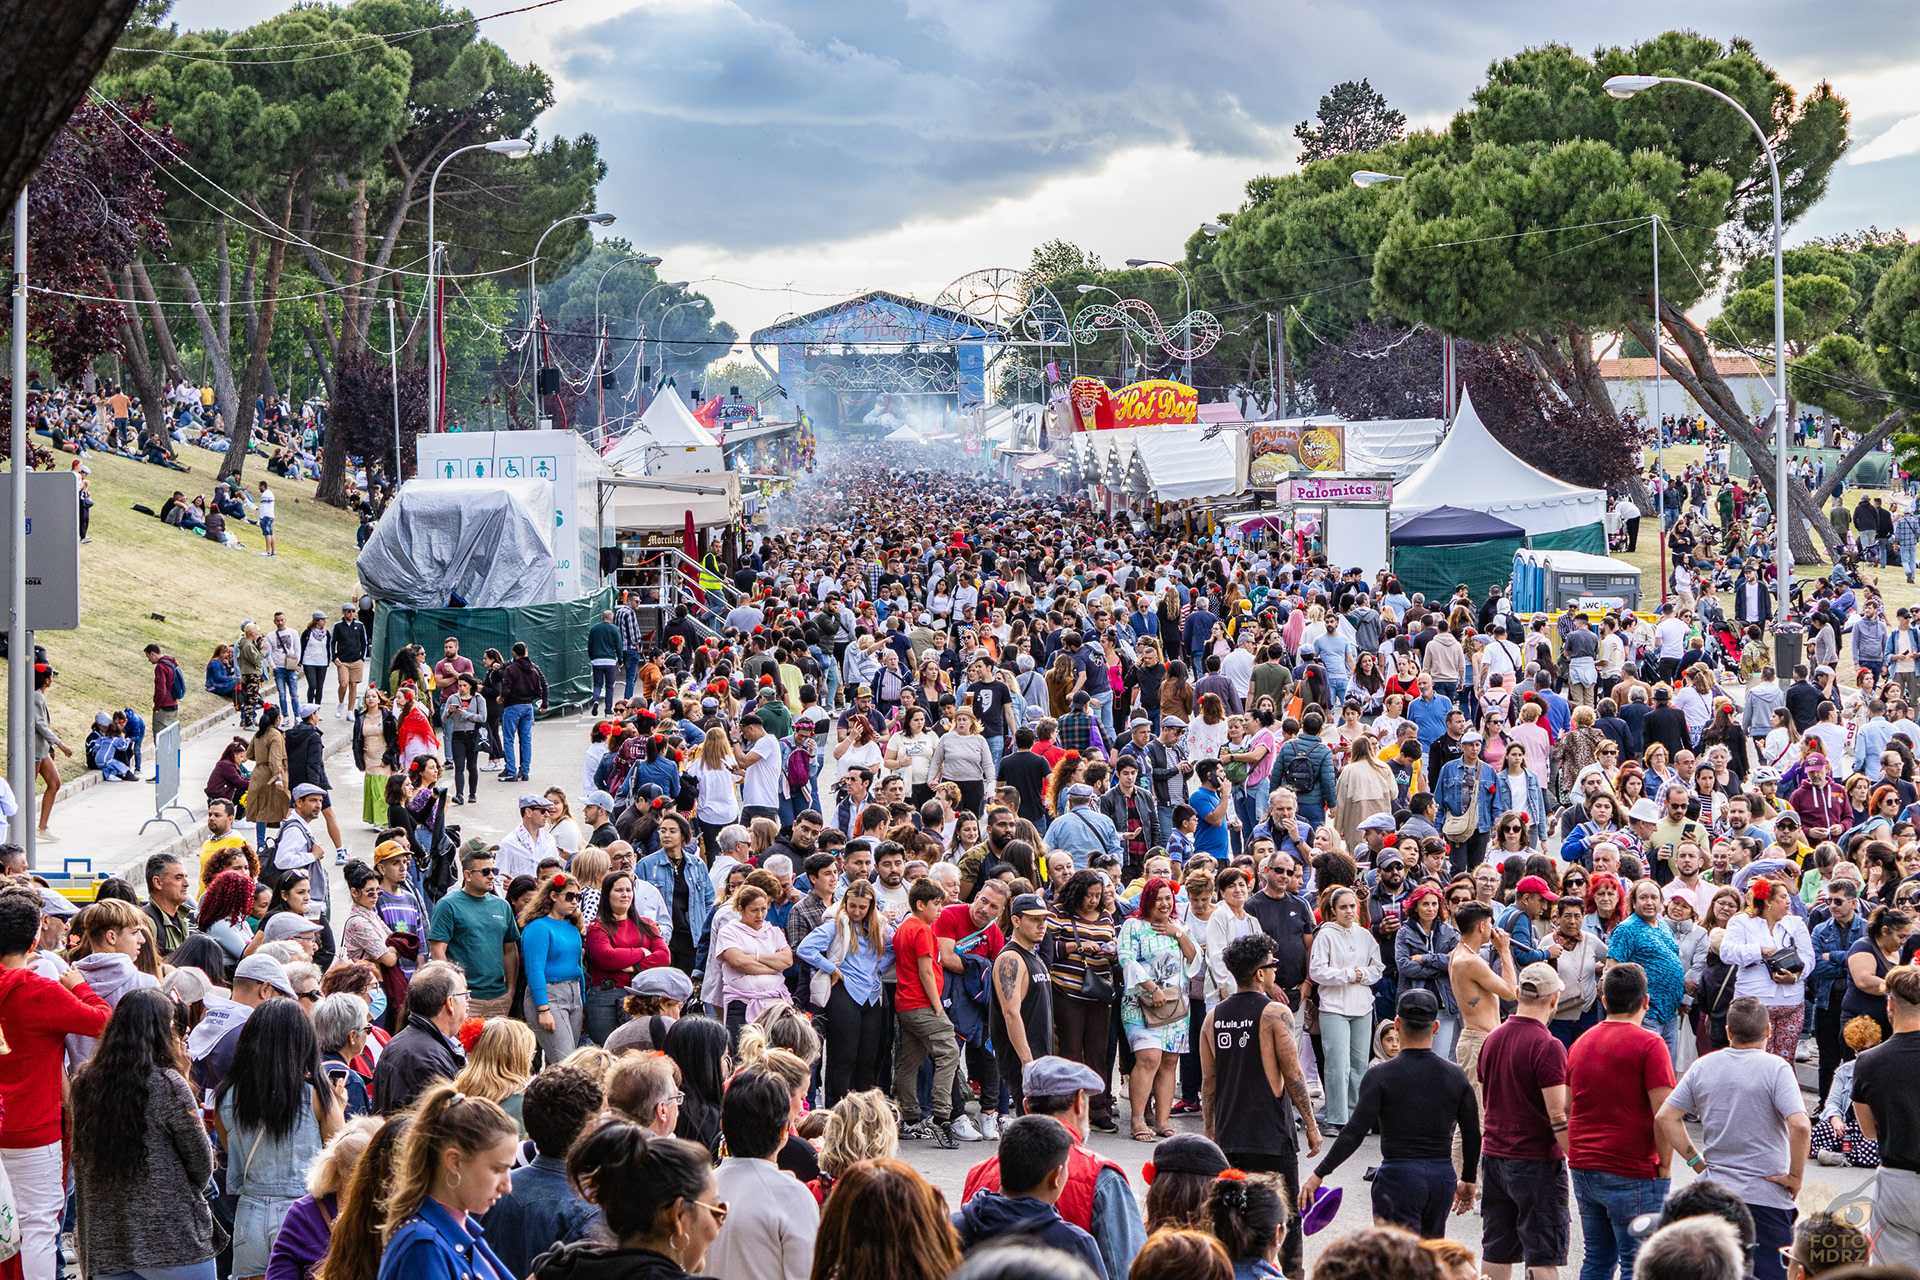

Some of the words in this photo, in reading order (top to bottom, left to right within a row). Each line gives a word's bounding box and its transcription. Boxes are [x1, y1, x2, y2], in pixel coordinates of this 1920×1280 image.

[1115, 389, 1156, 421] Hot
[1157, 389, 1198, 424] Dog
[1251, 429, 1298, 446] Bryan
[1297, 483, 1372, 499] Palomitas
[647, 535, 684, 546] Morcillas
